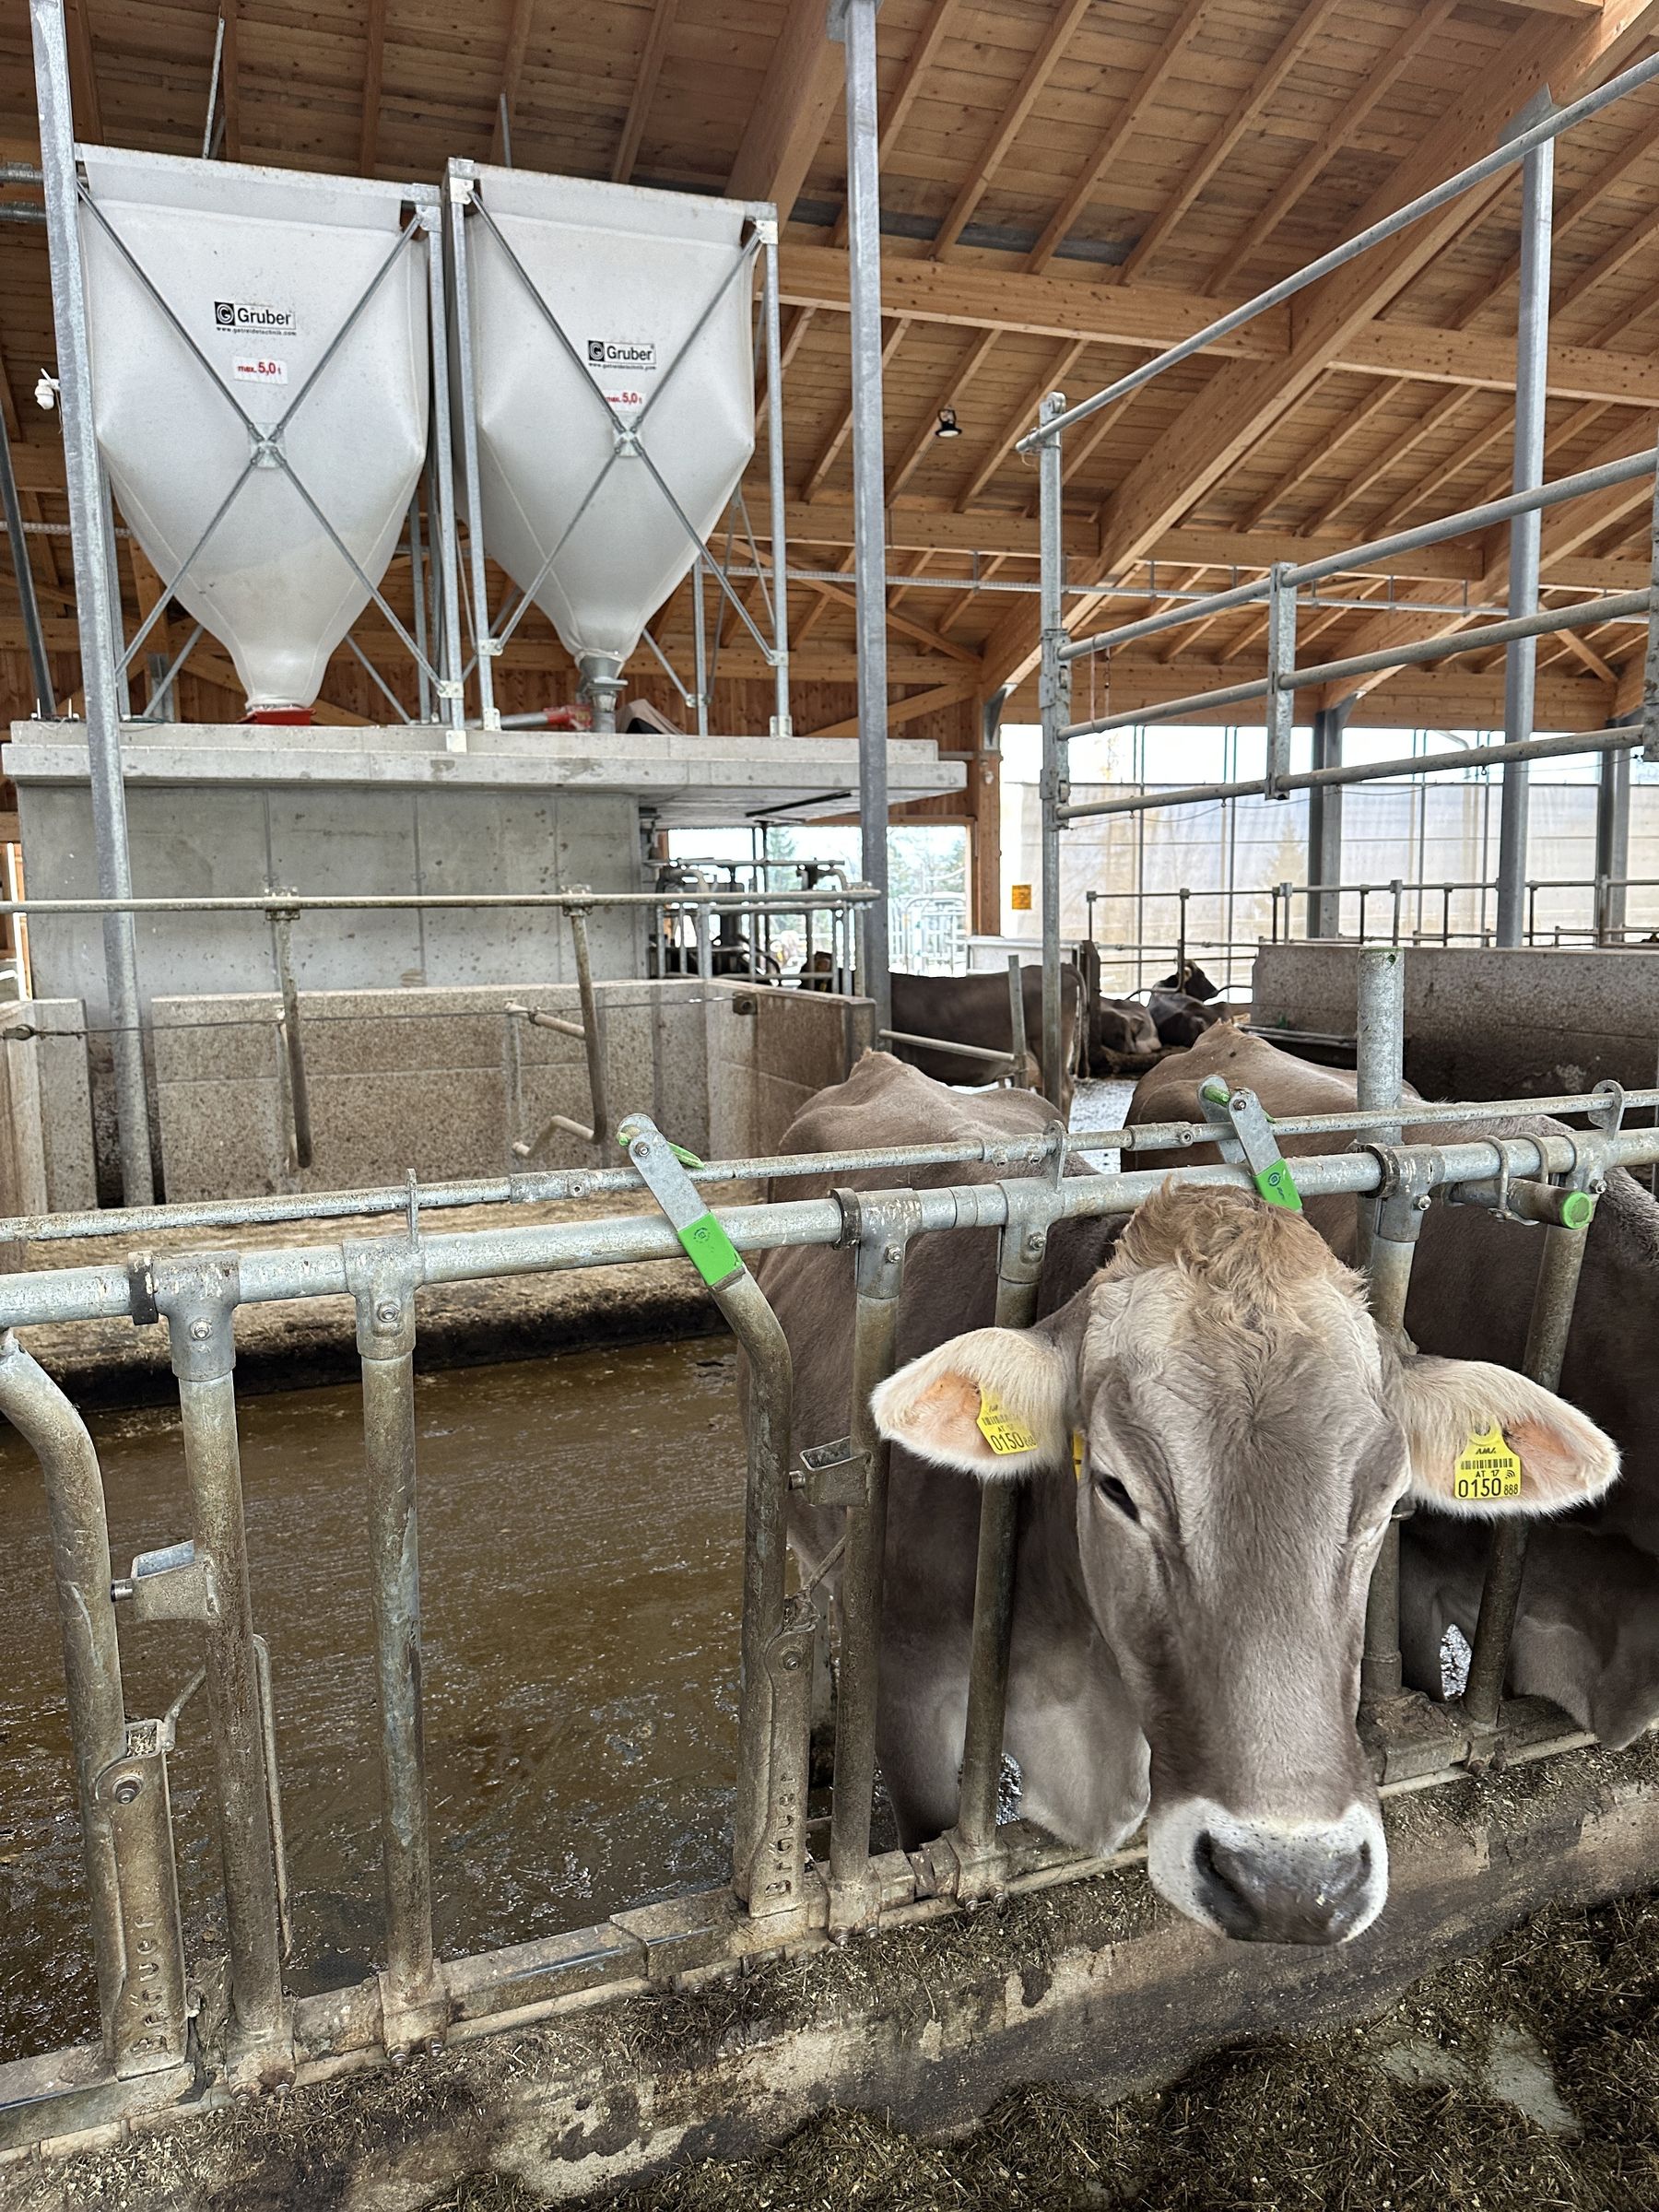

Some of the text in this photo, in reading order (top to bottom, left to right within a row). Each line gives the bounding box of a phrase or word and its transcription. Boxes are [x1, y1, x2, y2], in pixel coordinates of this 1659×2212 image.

[237, 308, 291, 324] Gruber
[606, 346, 653, 360] Gruber
[238, 365, 257, 373] max.
[258, 361, 276, 375] 5,0
[622, 392, 639, 405] 5,0
[990, 1431, 1025, 1452] 0150
[1490, 1469, 1500, 1477] 17
[1458, 1477, 1519, 1498] 0150 888
